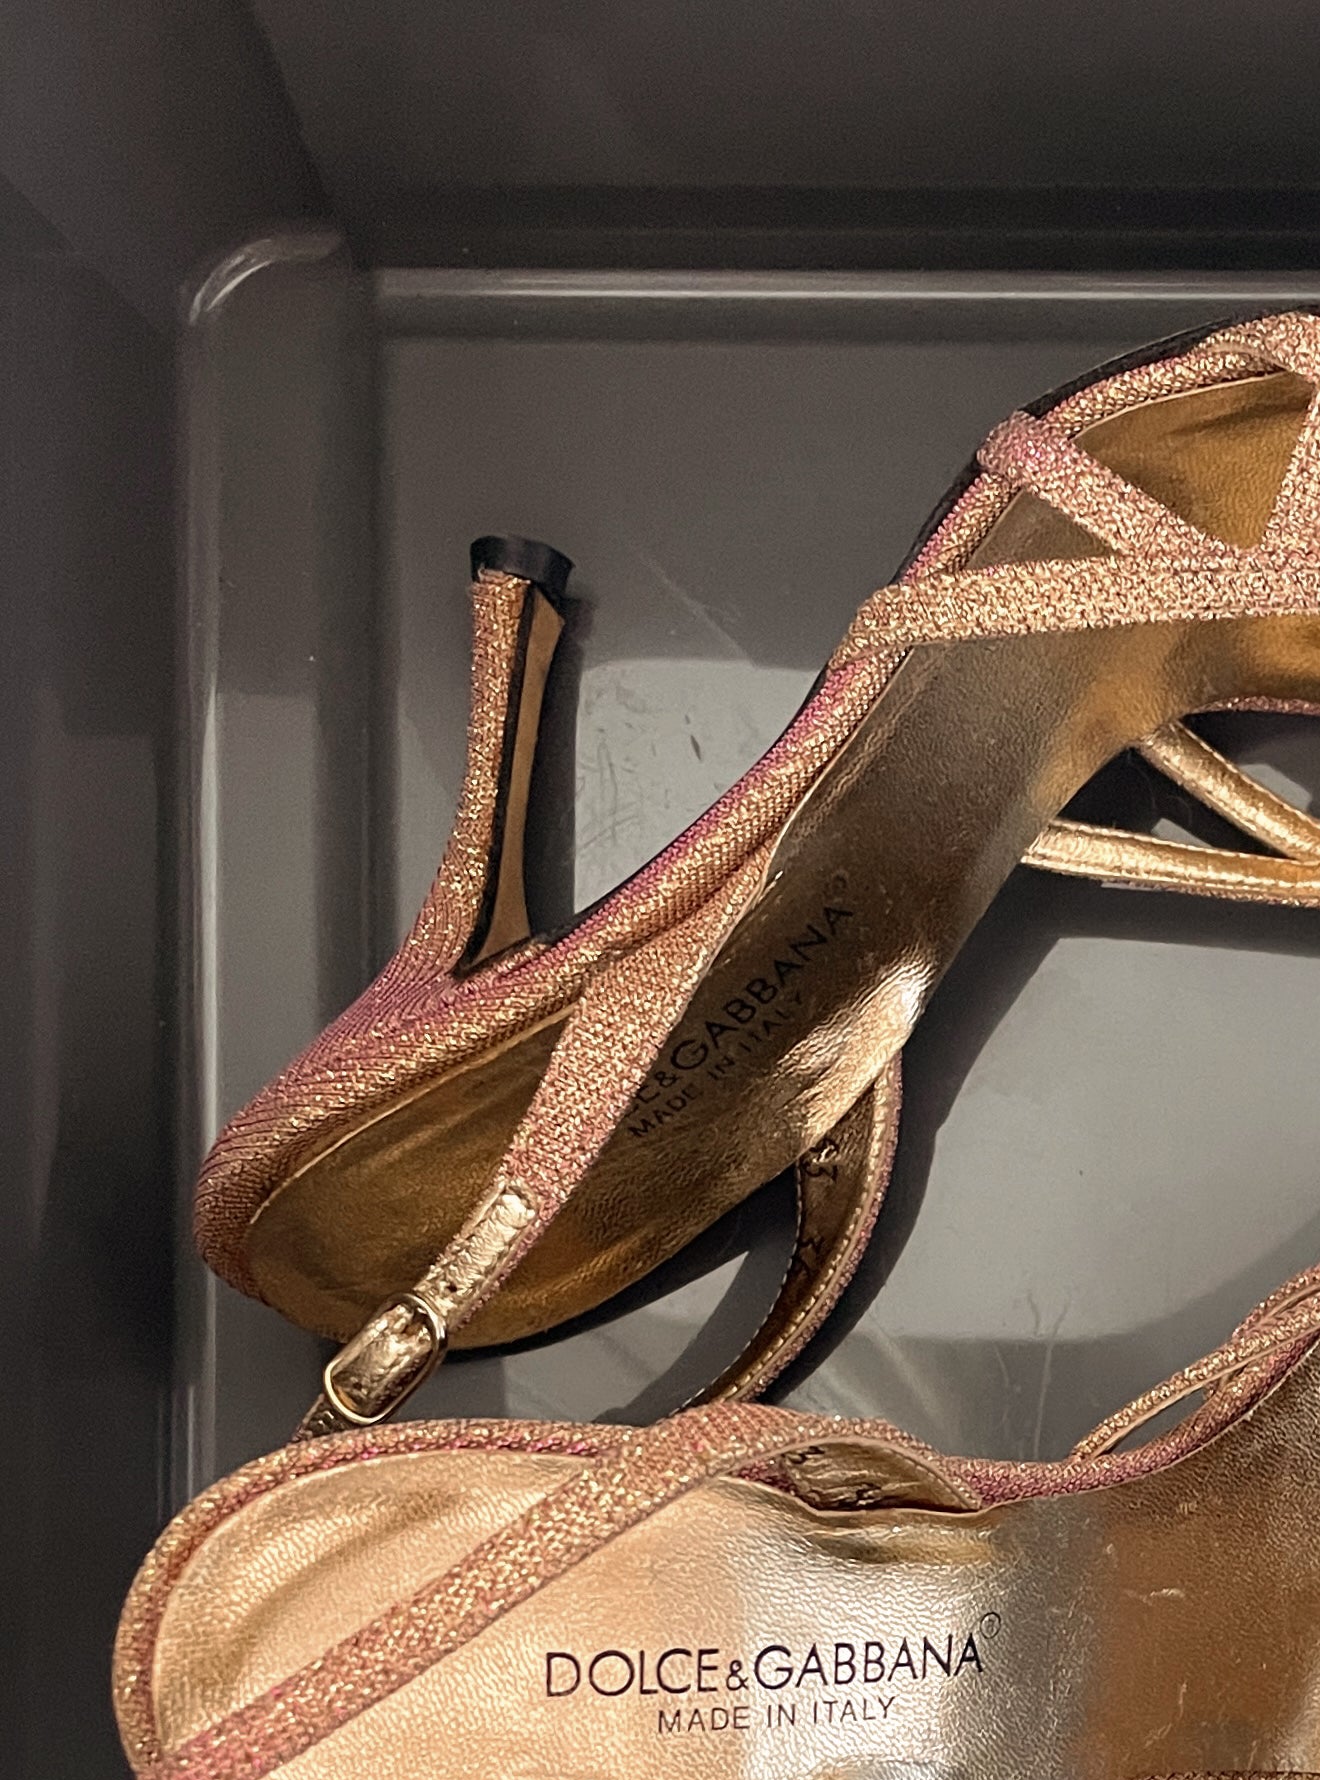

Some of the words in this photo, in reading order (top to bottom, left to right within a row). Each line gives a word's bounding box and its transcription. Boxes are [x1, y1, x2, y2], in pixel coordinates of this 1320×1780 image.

[629, 1083, 703, 1137] MADE
[707, 1056, 735, 1081] IN
[740, 992, 802, 1053] ITALY
[545, 1632, 984, 1698] DOLCE&GABBANA
[657, 1705, 750, 1734] MADE
[766, 1703, 796, 1727] IN
[812, 1695, 896, 1725] ITALY
